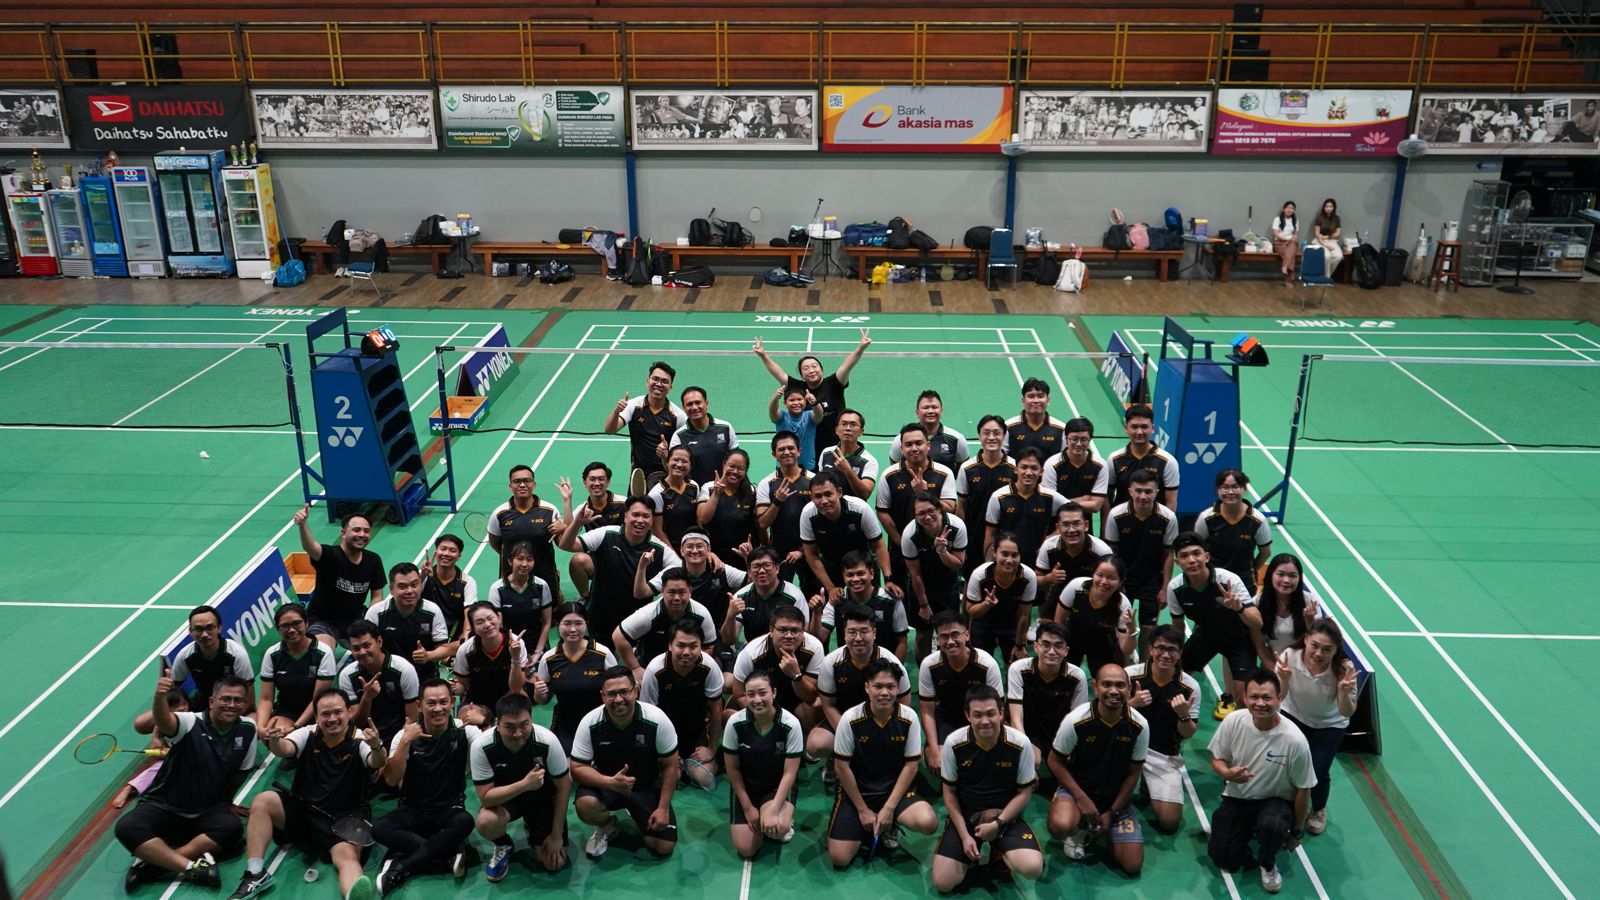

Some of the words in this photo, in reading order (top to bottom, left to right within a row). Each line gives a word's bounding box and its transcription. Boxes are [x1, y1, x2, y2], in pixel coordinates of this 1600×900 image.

[462, 93, 497, 102] Shirudo
[499, 93, 516, 102] Lab
[138, 101, 225, 116] DAIHATSU
[898, 106, 926, 115] Bank
[897, 117, 942, 129] akasia
[944, 119, 974, 129] mas
[94, 127, 153, 140] Daihatsu
[156, 126, 228, 140] Sahabatku
[243, 308, 315, 316] YONEX
[754, 315, 826, 323] YONEX
[1276, 320, 1355, 328] YONEX
[334, 395, 353, 420] 2
[1163, 397, 1170, 422] 1
[1203, 410, 1218, 435] 1
[226, 575, 293, 648] YONEX
